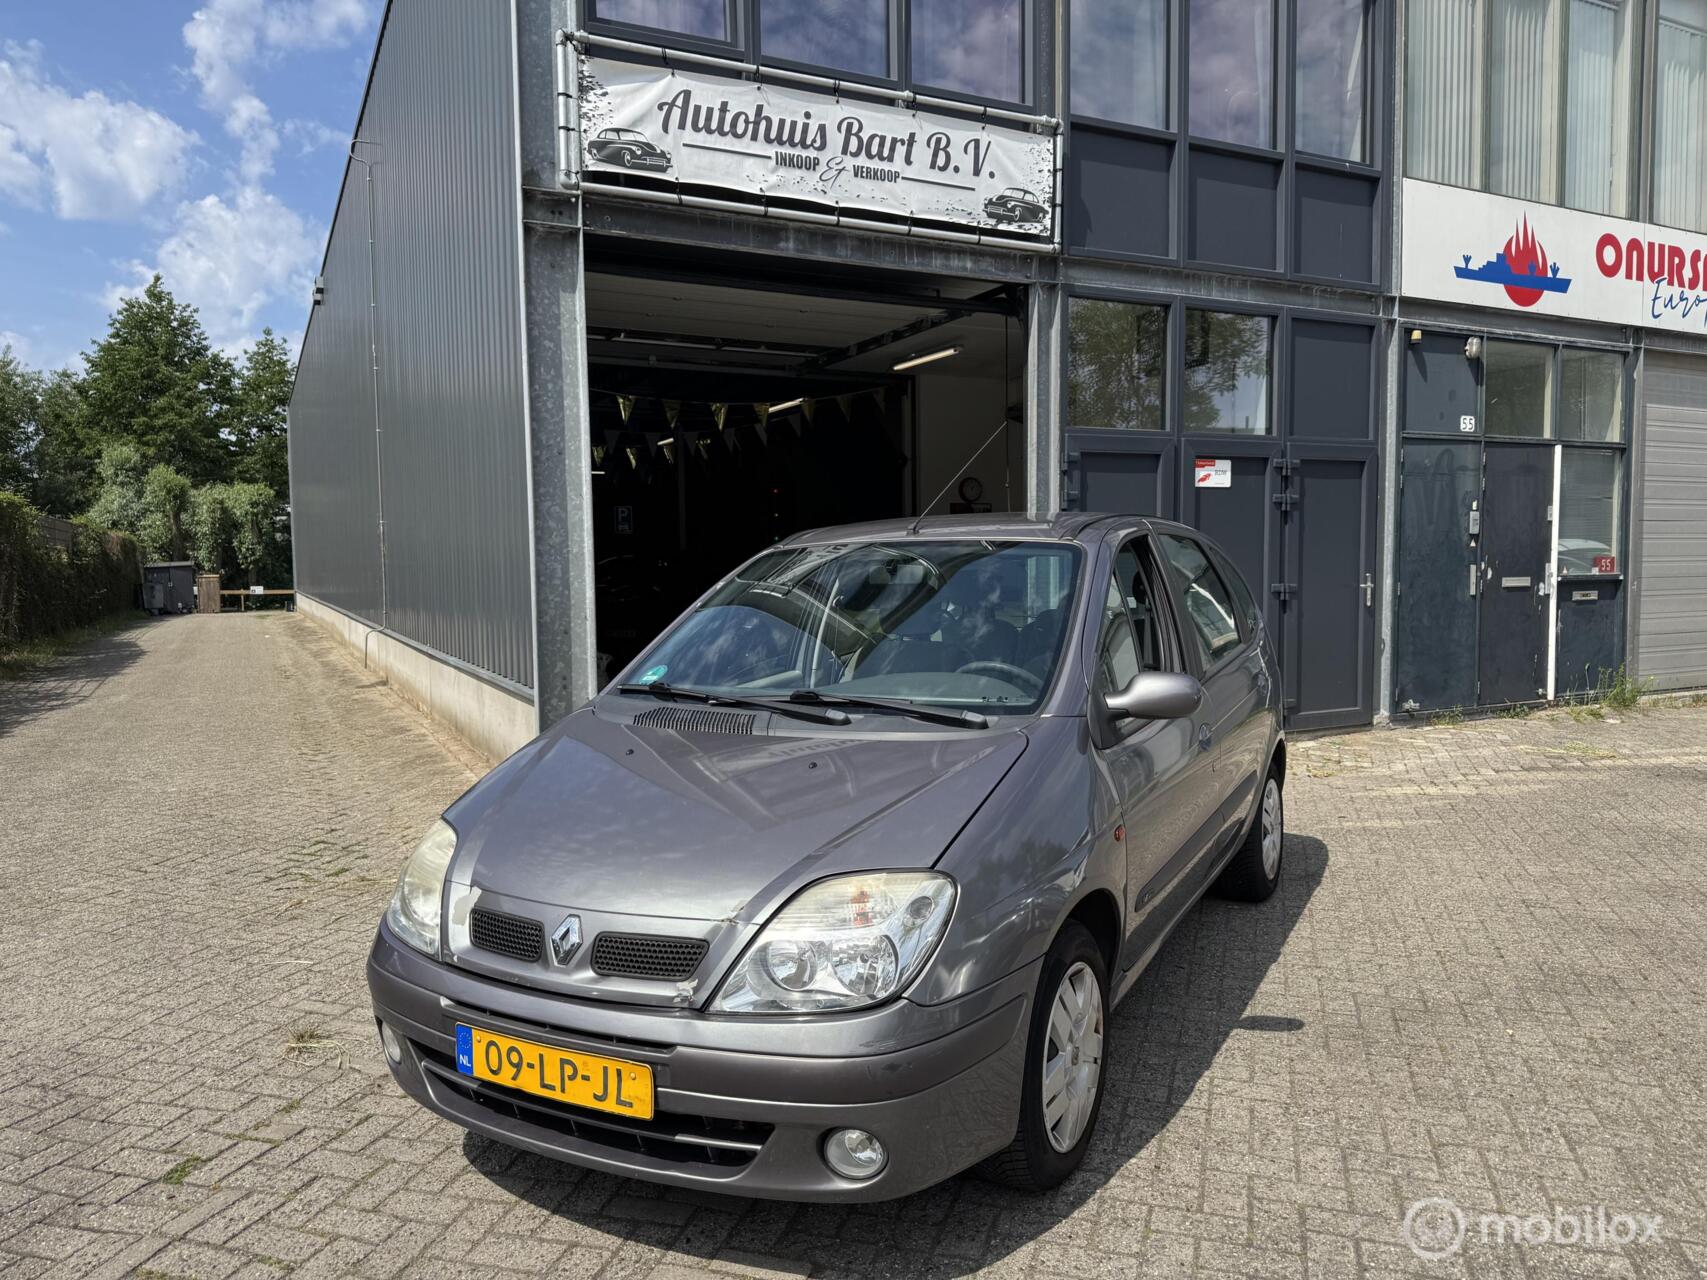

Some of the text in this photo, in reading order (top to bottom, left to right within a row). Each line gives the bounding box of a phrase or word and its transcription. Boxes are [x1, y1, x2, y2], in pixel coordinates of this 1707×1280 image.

[657, 89, 996, 179] Autohuis Bart B.V.
[775, 151, 820, 171] INKOOP
[852, 164, 900, 183] VERKOOP
[1462, 417, 1474, 430] 55
[1601, 559, 1611, 571] 55
[459, 1054, 472, 1067] NL
[485, 1040, 634, 1108] 09-LP-JL
